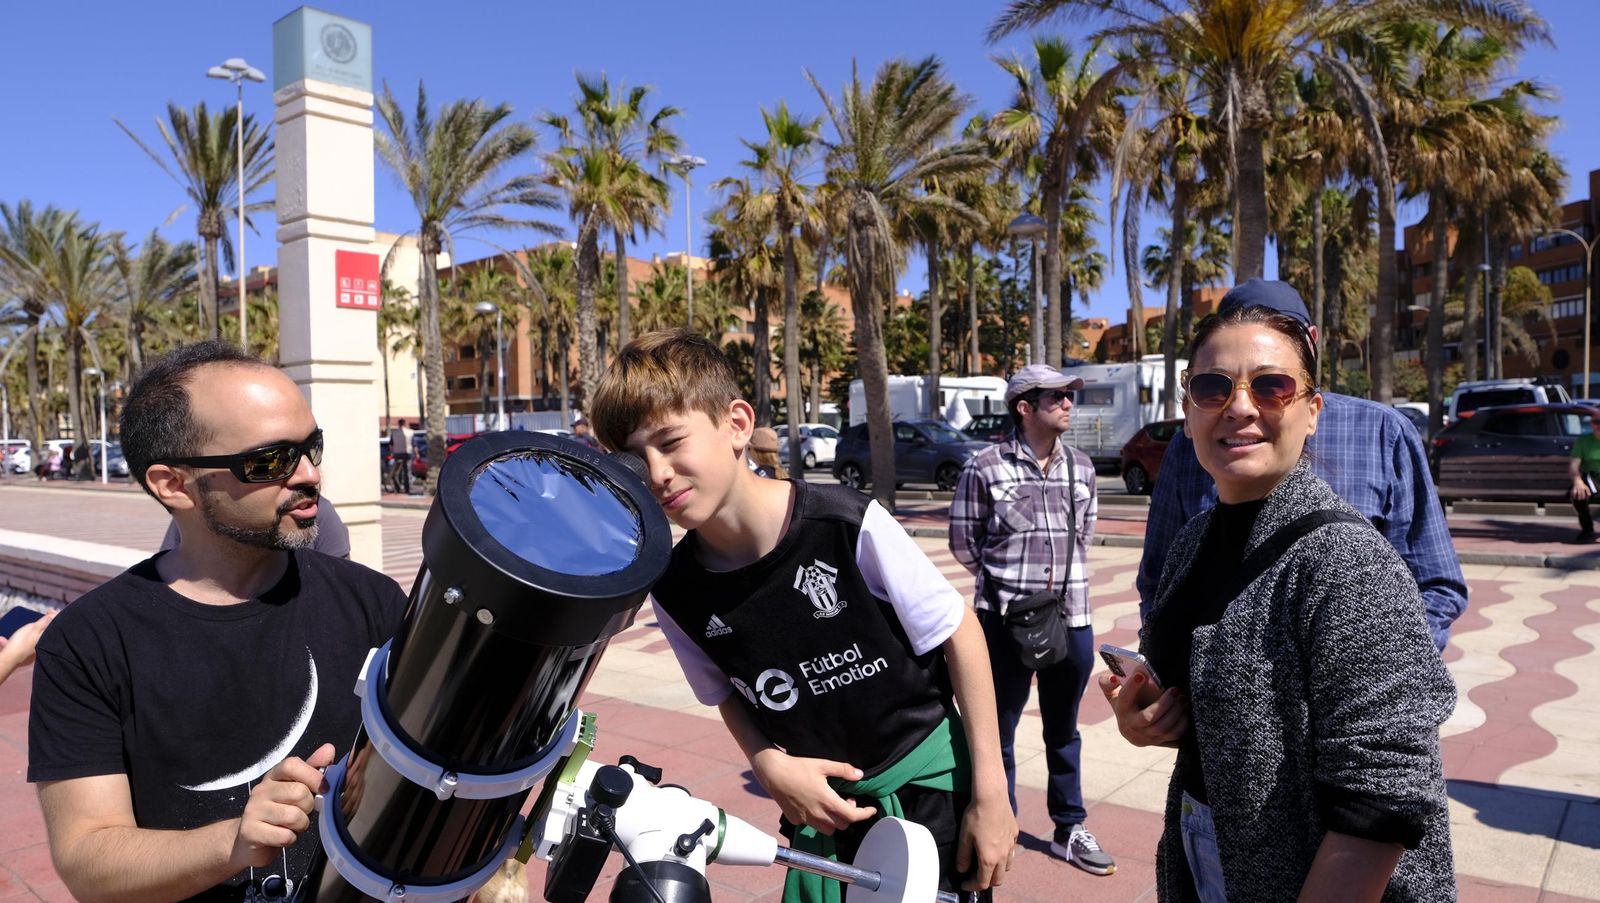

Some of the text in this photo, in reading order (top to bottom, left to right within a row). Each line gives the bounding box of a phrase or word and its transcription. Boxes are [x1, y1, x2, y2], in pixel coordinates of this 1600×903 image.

[705, 626, 733, 638] adidas
[799, 643, 863, 678] Fútbol
[808, 657, 888, 695] Emotion
